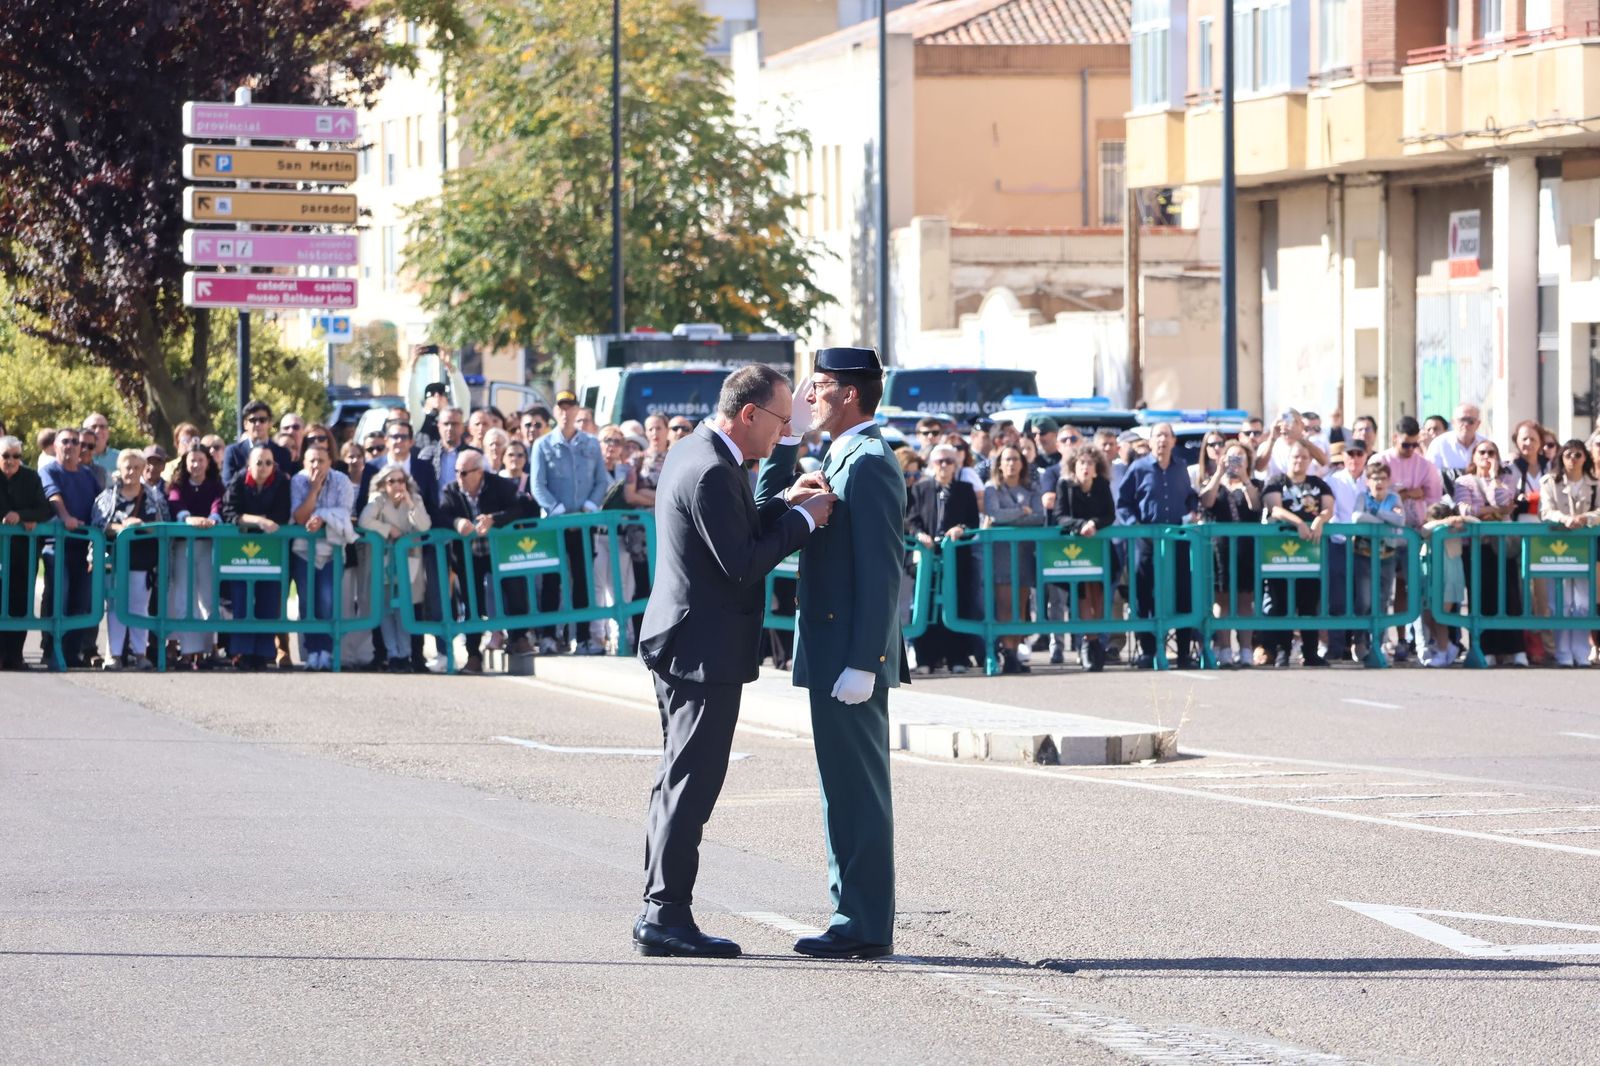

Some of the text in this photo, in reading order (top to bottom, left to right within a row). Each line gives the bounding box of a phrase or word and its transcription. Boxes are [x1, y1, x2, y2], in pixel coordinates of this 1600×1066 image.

[197, 120, 260, 132] provincial
[218, 156, 230, 170] P
[277, 160, 302, 170] San
[301, 204, 352, 214] parador
[256, 281, 352, 292] catedral castillo
[246, 292, 352, 304] museo Baltasar Lobo
[646, 403, 709, 415] GUARDIA
[917, 401, 980, 414] GUARDIA
